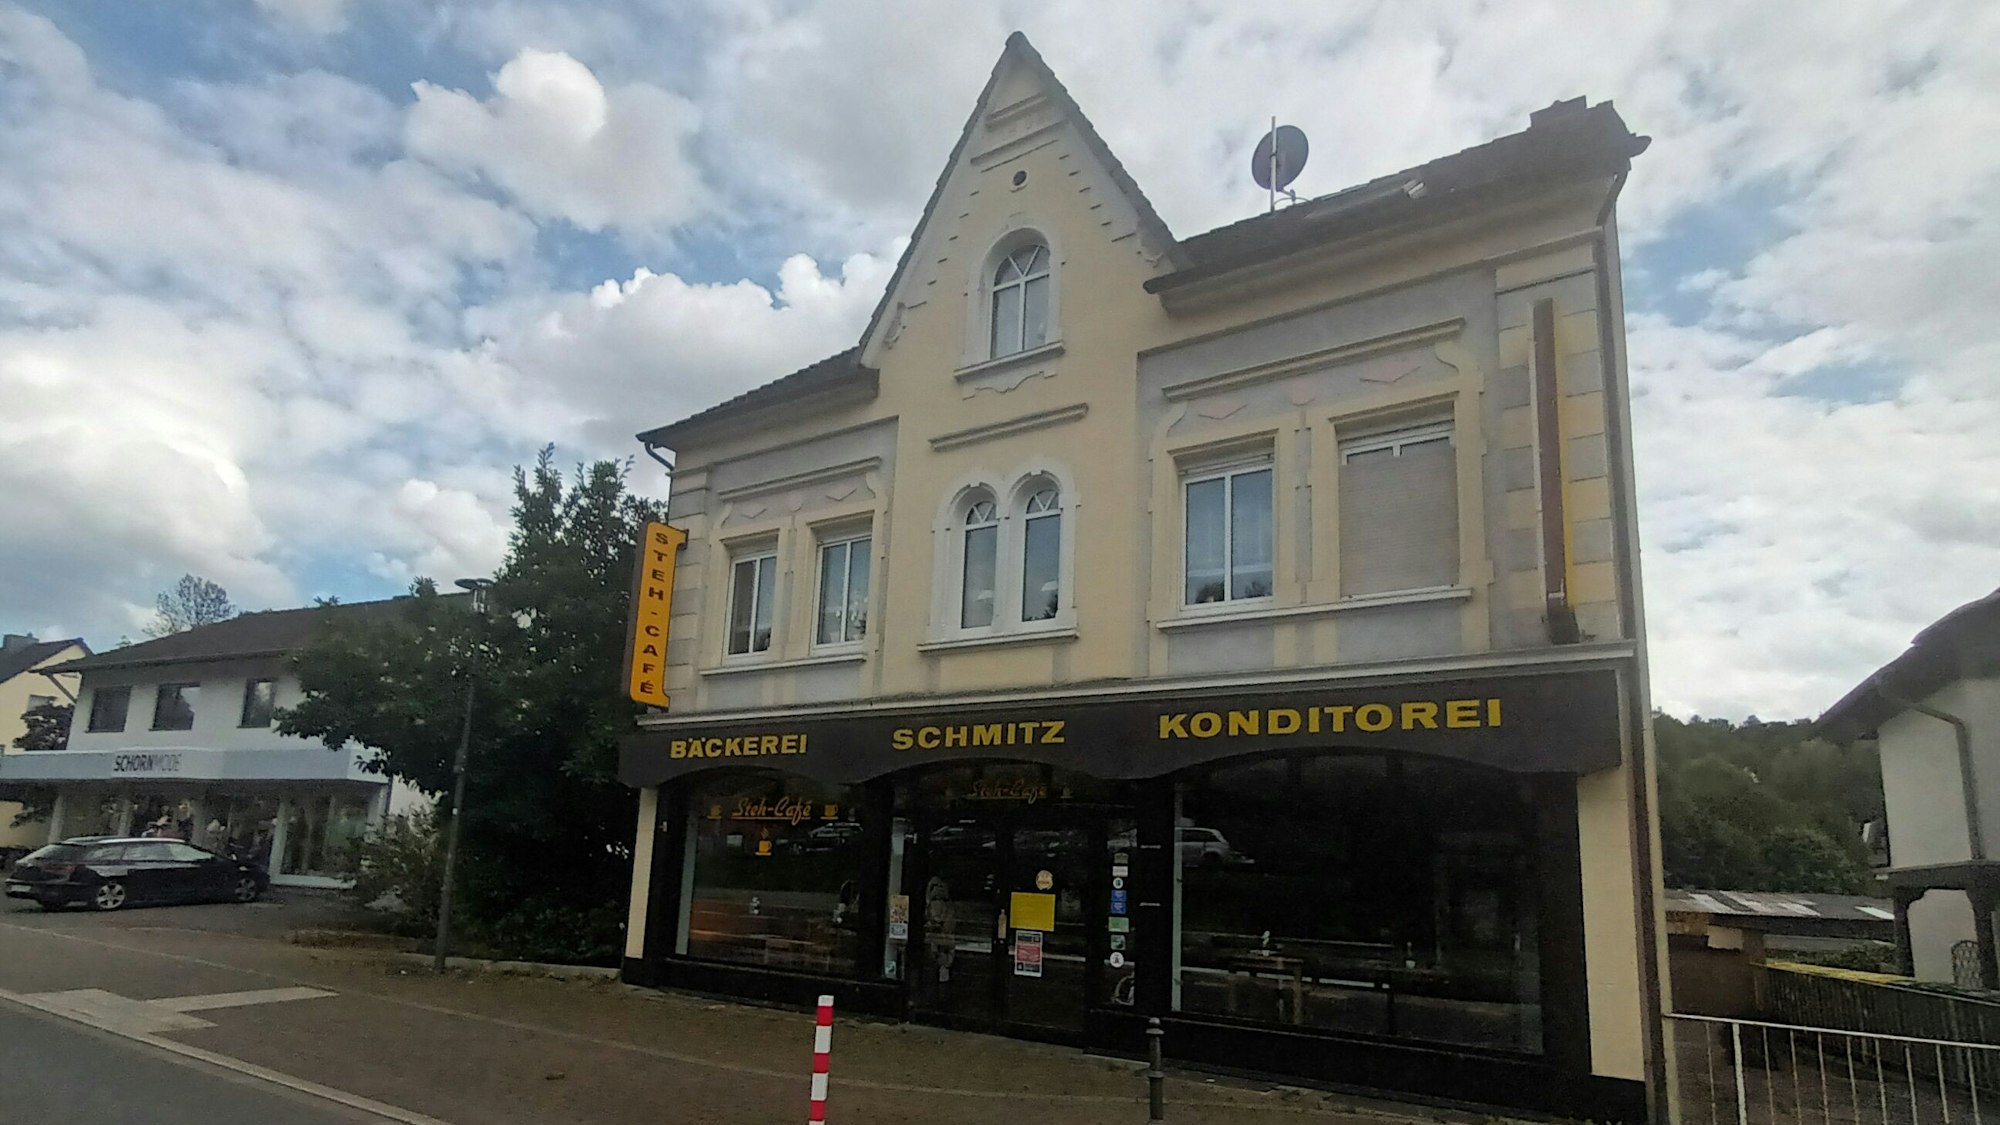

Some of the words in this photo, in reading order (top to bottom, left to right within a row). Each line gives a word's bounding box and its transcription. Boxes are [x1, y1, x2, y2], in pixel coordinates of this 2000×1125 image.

[640, 532, 668, 694] STEH-CAFÉ
[670, 734, 808, 759] BÄCKEREI
[892, 721, 1066, 751] SCHMITZ
[1159, 699, 1501, 739] KONDITOREI
[731, 797, 812, 826] Steh-Café
